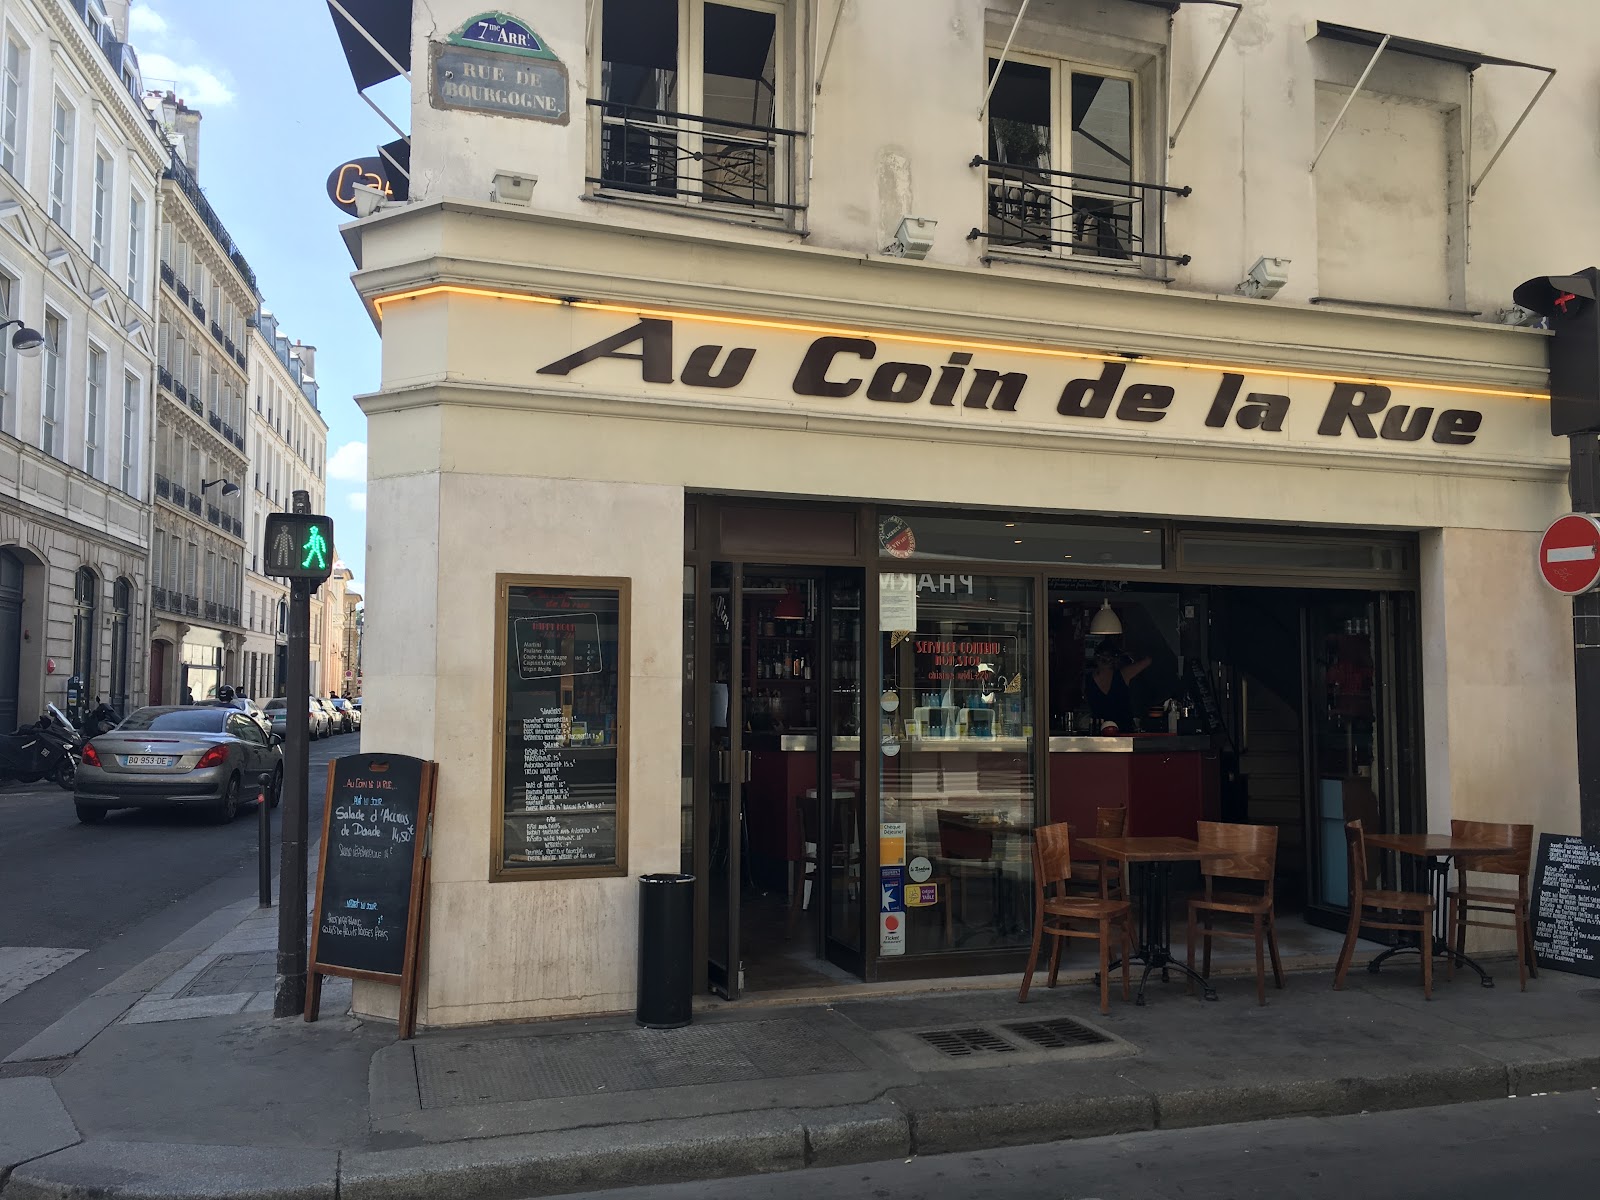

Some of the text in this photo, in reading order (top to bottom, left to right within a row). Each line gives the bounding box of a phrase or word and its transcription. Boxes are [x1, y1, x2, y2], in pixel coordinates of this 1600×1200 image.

[462, 62, 543, 88] RUE DE
[535, 316, 1483, 445] Au Coin de la Rue
[915, 641, 1001, 655] SERVICE CONTINU
[935, 655, 982, 666] NON STOP
[335, 806, 365, 822] Salade
[340, 824, 350, 837] de
